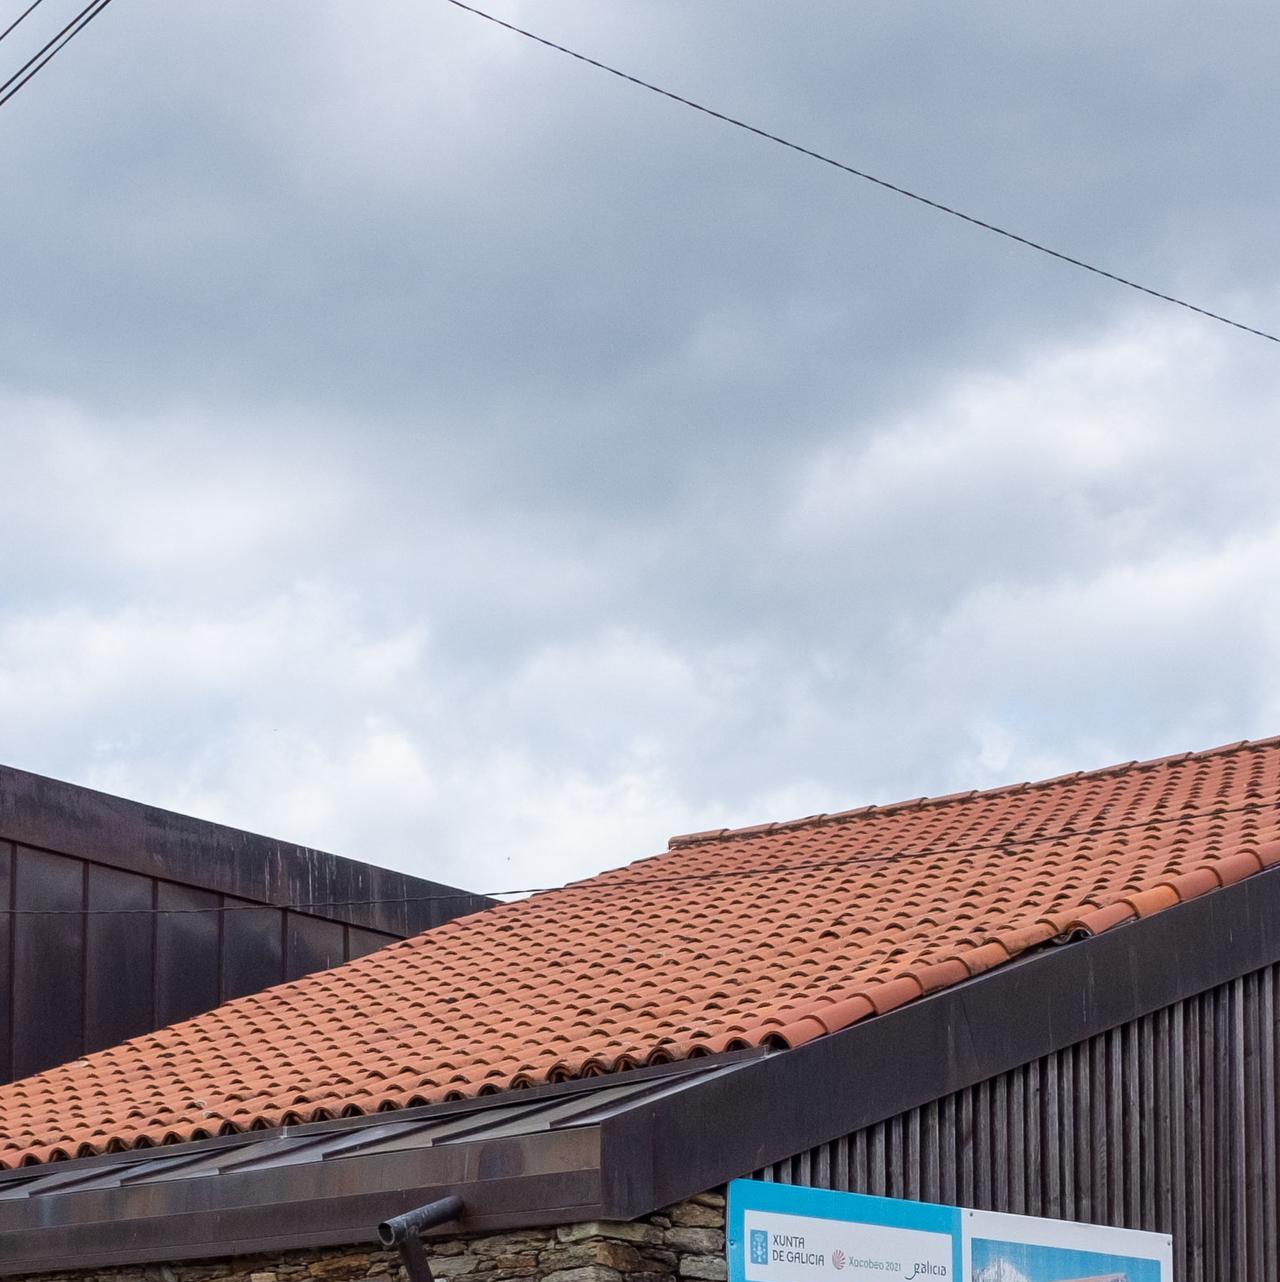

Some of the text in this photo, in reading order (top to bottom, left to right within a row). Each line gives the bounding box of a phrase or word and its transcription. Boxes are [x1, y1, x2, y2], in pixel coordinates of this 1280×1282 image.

[773, 1235, 805, 1249] XUNTA
[773, 1250, 825, 1267] DE GALICIA
[849, 1255, 901, 1272] Xacobeo 2021
[905, 1261, 947, 1280] galicia
